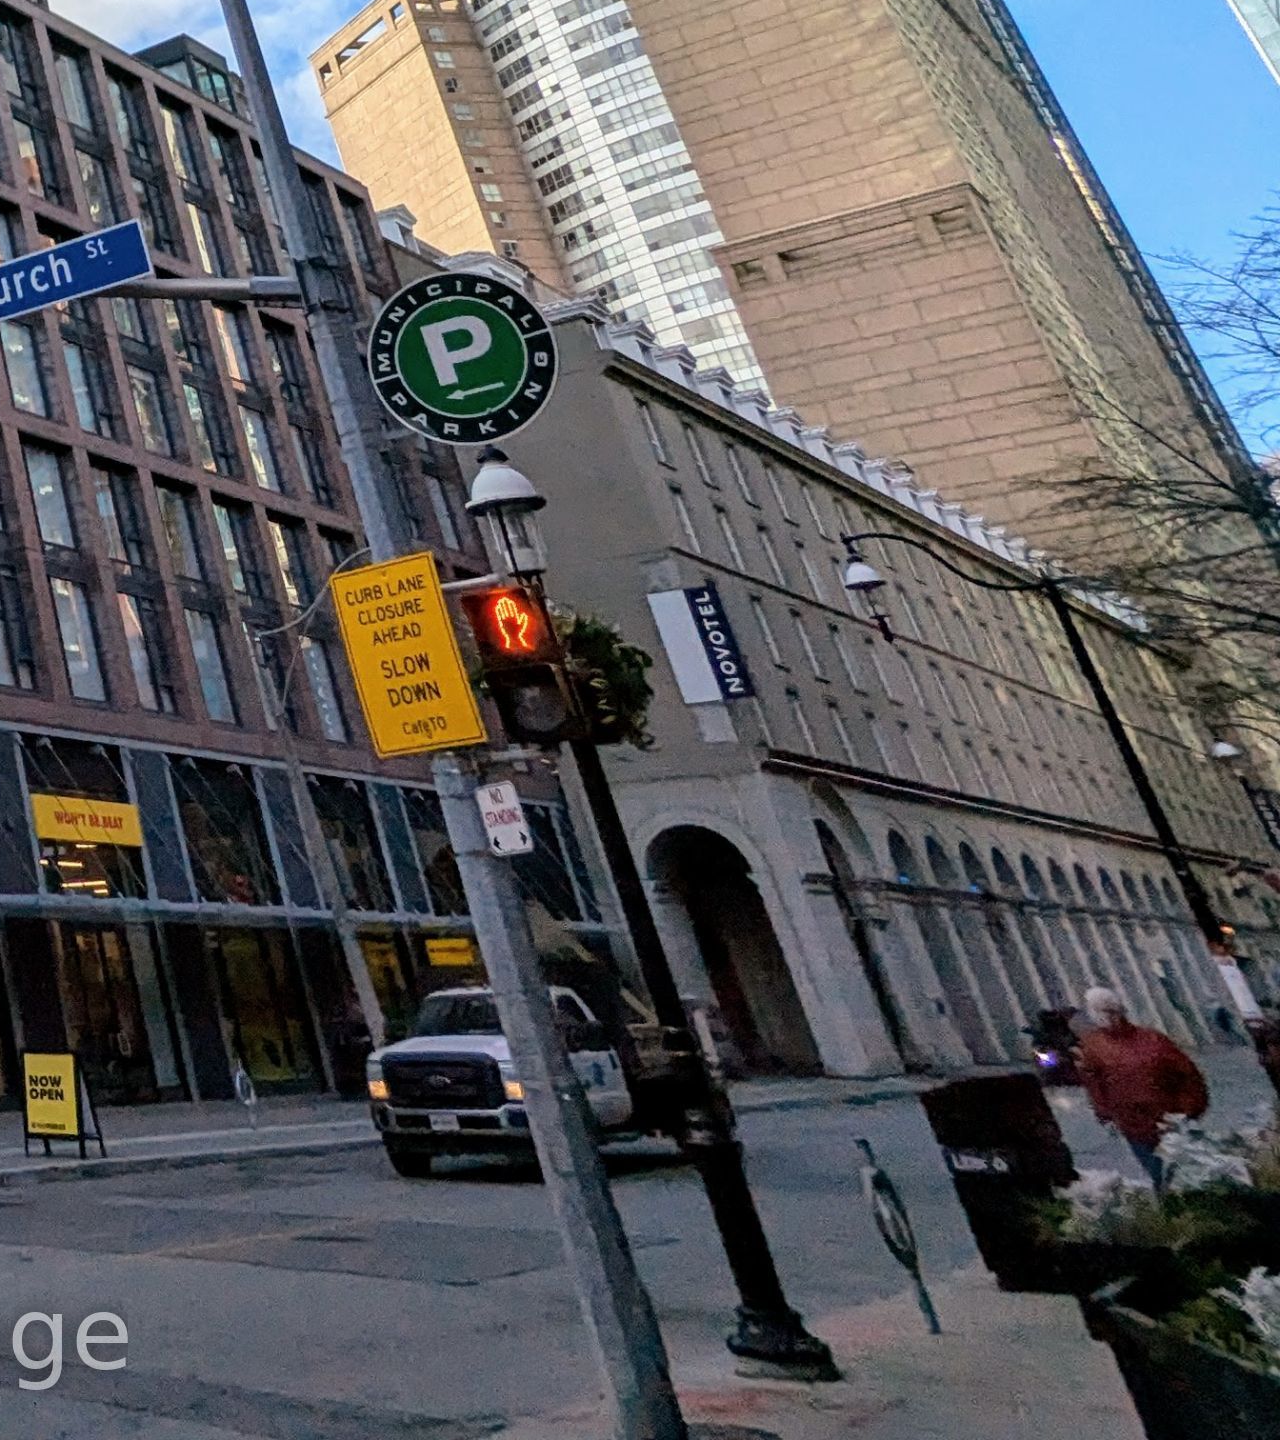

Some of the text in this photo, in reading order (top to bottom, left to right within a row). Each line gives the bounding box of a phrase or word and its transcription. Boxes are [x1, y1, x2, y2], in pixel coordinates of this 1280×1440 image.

[84, 237, 110, 259] St
[377, 280, 534, 372] MUNICIPAL
[420, 315, 492, 386] P
[391, 351, 548, 435] PARKING
[345, 574, 427, 606] CURB LANE
[358, 598, 425, 626] CLOSURE
[372, 622, 422, 647] AHEAD
[695, 591, 744, 693] NOVOTEL
[381, 652, 431, 679] SLOW
[386, 681, 442, 708] DOWN
[53, 810, 87, 826] WON'T
[28, 1074, 62, 1088] NOW
[29, 1088, 65, 1101] OPEN
